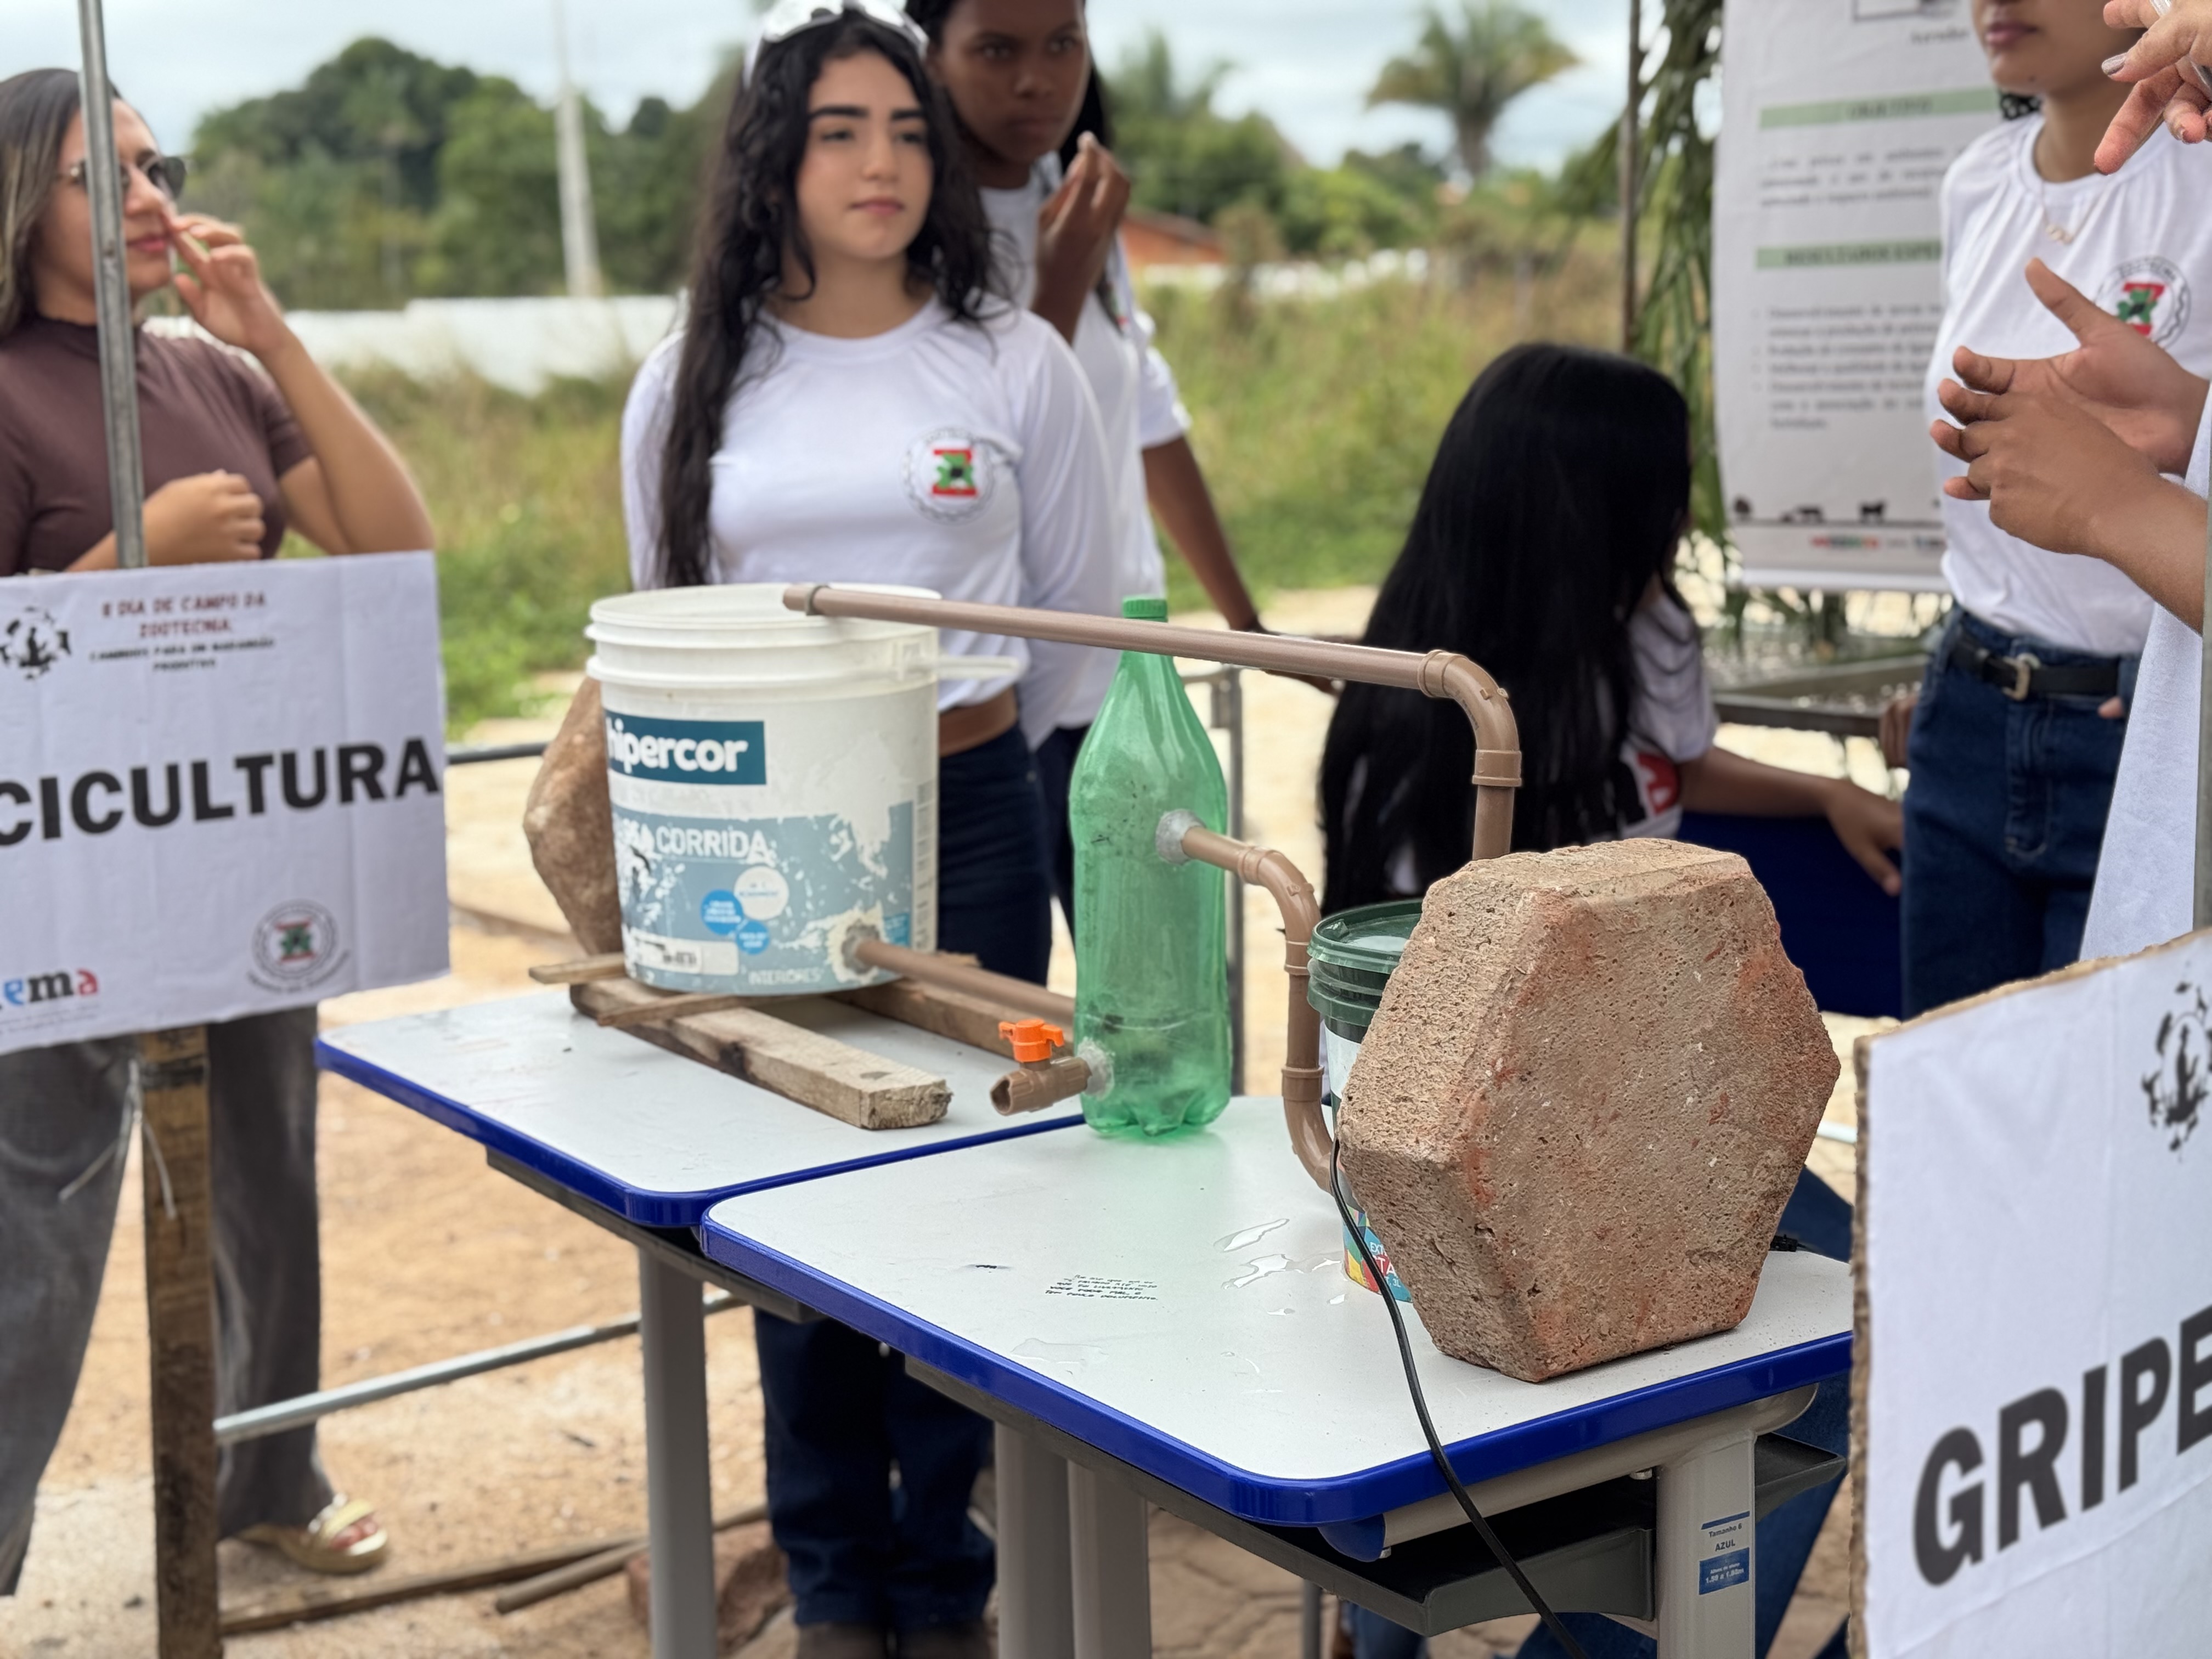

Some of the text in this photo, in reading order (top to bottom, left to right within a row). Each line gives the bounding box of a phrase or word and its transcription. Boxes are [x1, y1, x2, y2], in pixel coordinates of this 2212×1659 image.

[180, 593, 236, 611] CAMPO
[140, 619, 232, 638] ZOOTECNIA
[606, 716, 749, 775] hipercor
[656, 825, 769, 865] CORRIDA
[0, 968, 100, 1007] ema
[1708, 1525, 1737, 1538] Tamanho
[1715, 1538, 1736, 1552] AZUL
